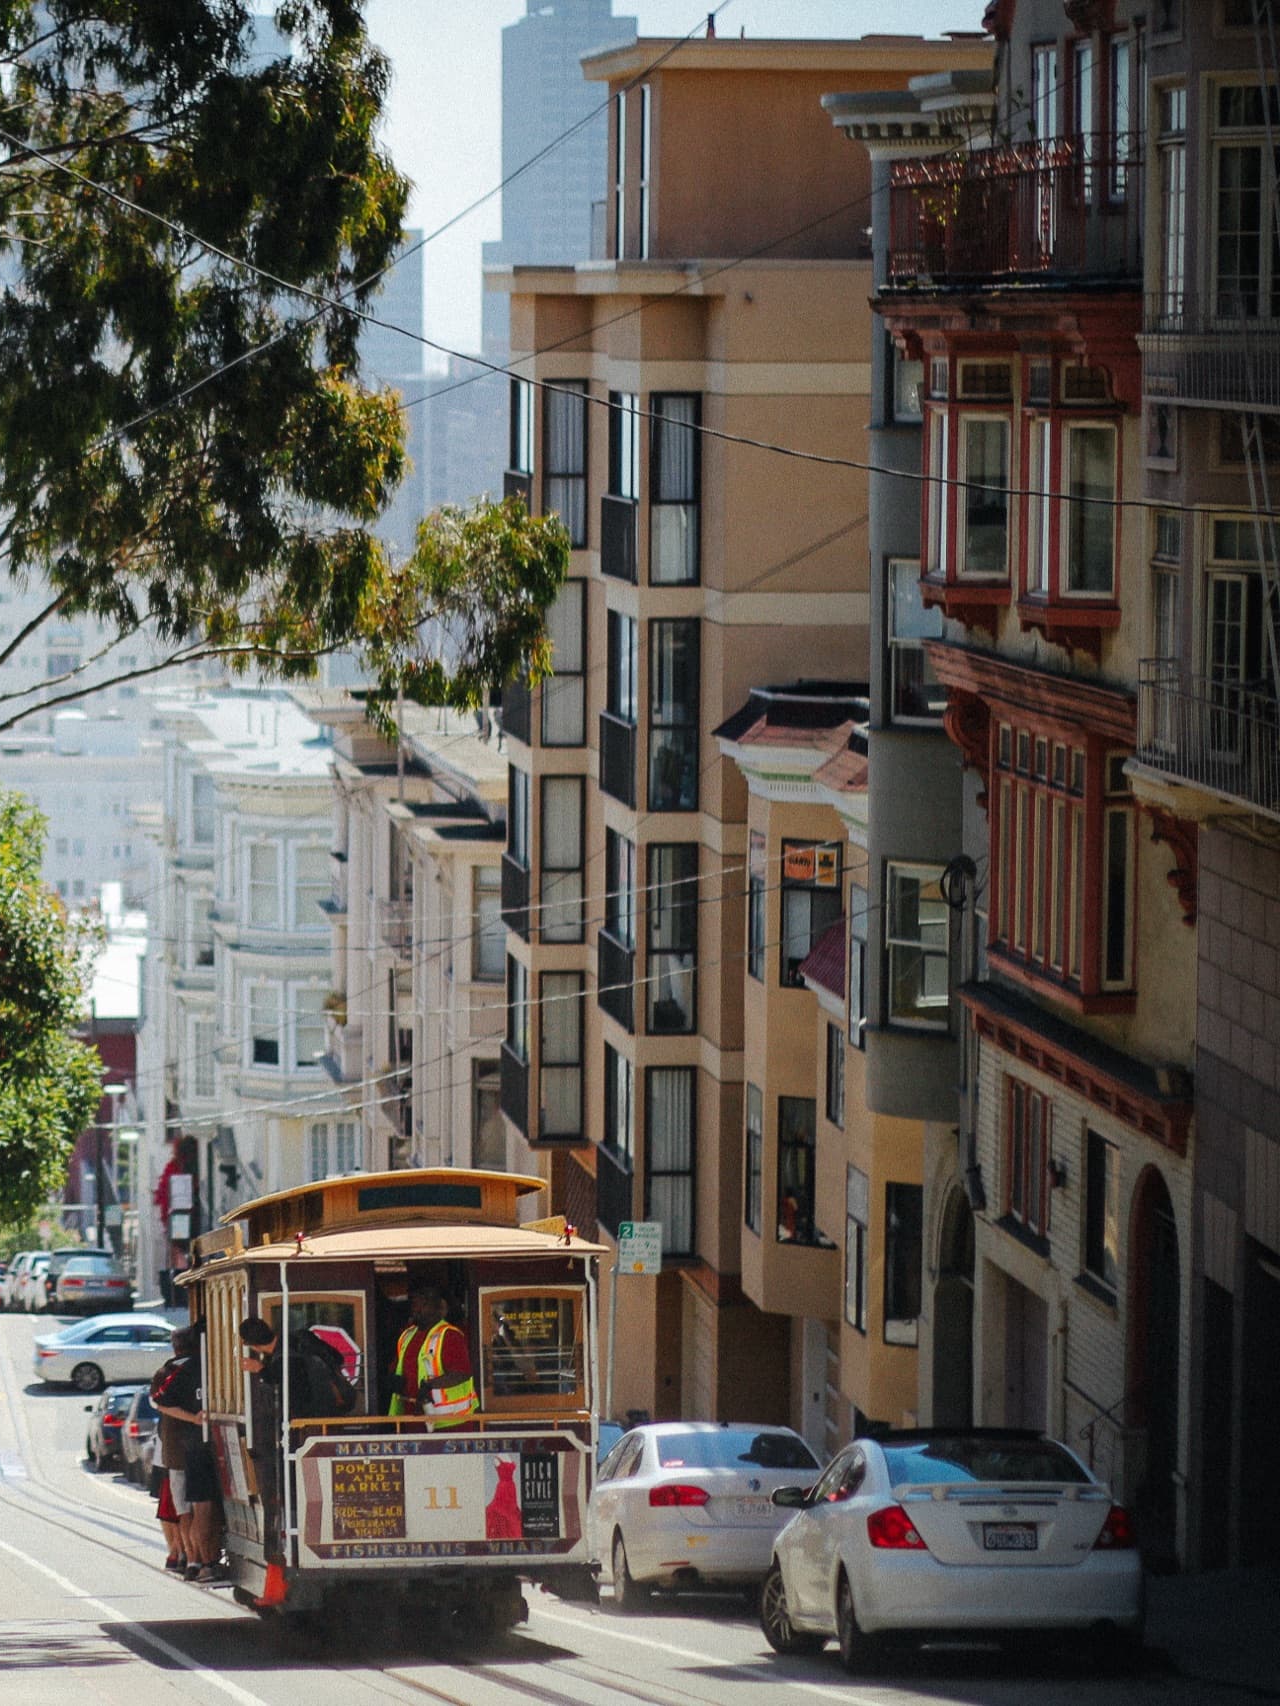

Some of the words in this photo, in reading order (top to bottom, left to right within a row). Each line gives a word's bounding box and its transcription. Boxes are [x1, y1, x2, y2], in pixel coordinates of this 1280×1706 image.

[622, 1226, 631, 1237] 2
[335, 1442, 421, 1456] MARKET
[335, 1463, 400, 1474] POWELL
[353, 1474, 385, 1482] AND
[334, 1481, 401, 1493] MARKET
[525, 1481, 551, 1499] STYLE
[424, 1486, 462, 1509] 11
[331, 1542, 466, 1557] FISHERMANS
